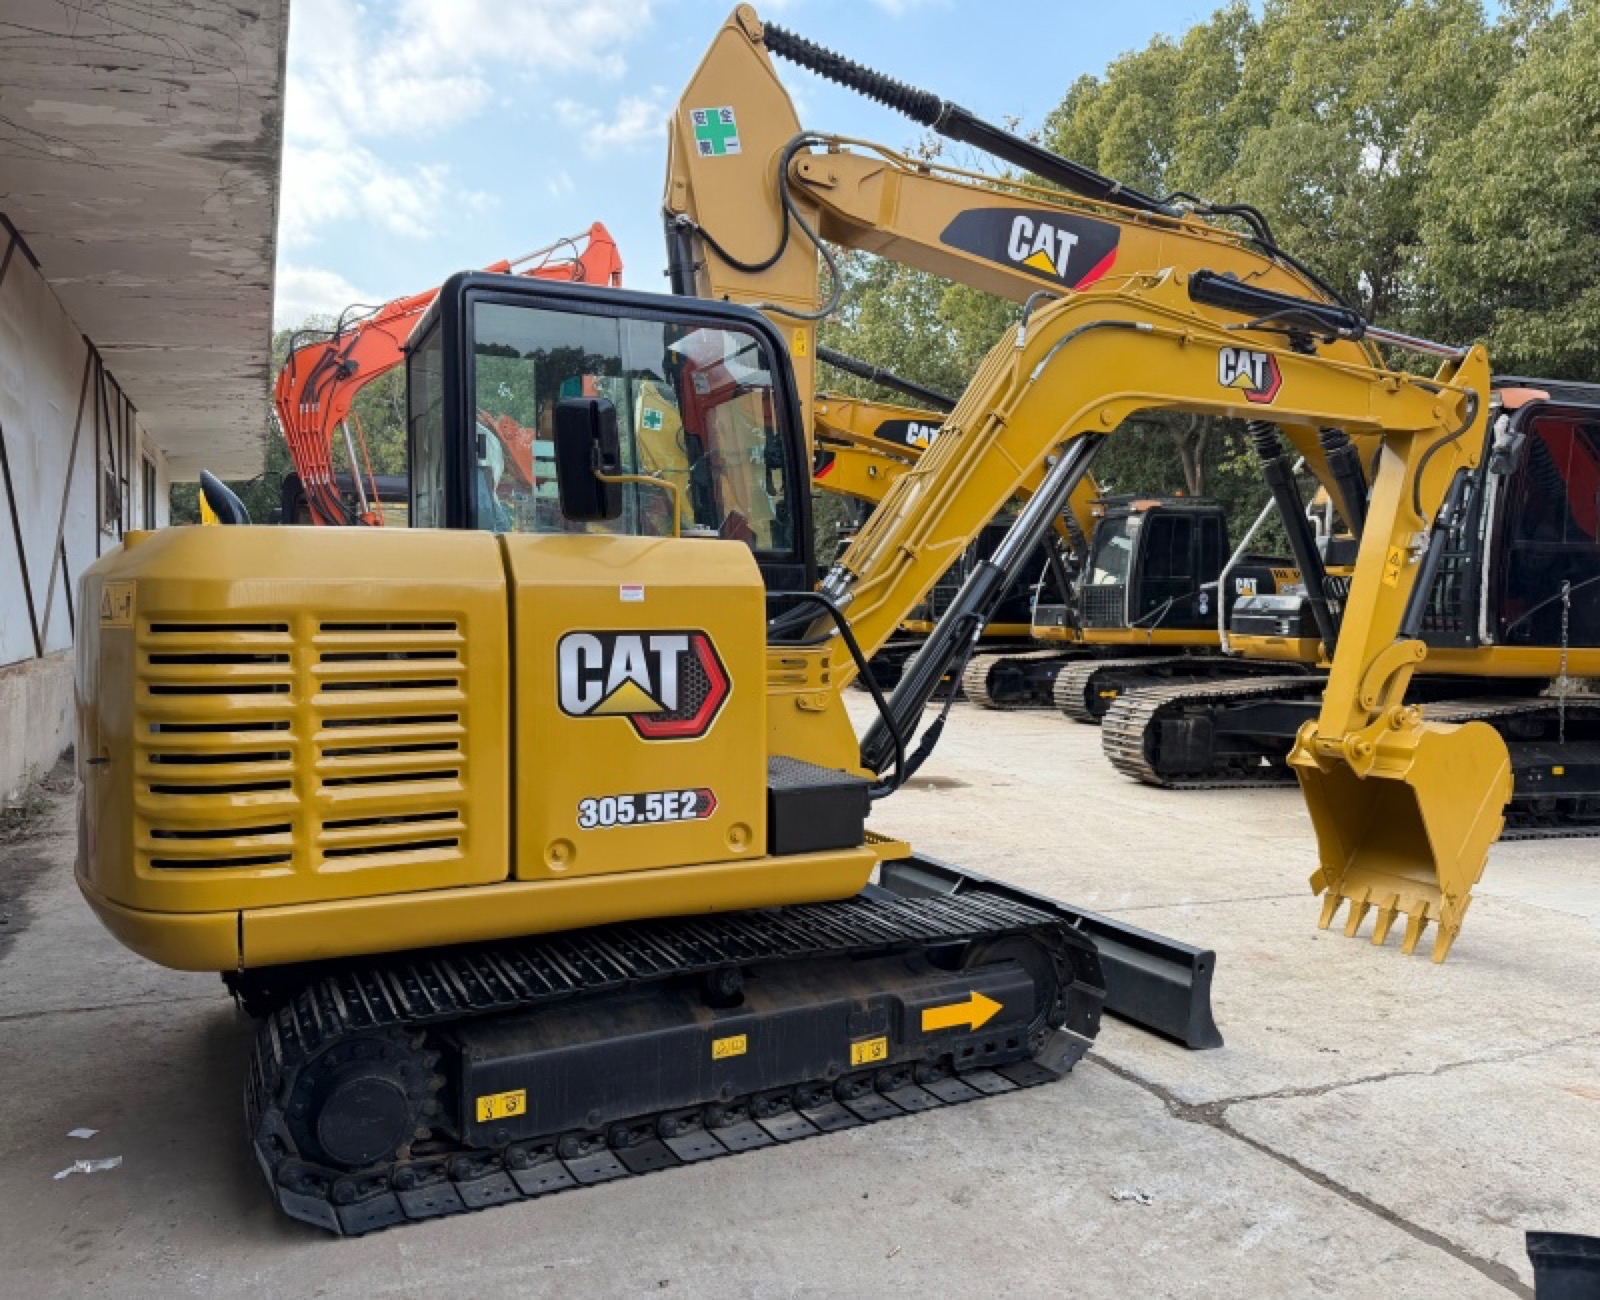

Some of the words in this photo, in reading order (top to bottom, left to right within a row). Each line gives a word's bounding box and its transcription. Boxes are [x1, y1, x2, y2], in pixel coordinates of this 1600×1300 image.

[1008, 215, 1079, 279] CAT
[1219, 347, 1267, 391] CAT
[559, 633, 689, 715] CAT
[579, 791, 697, 828] 305.5E2
